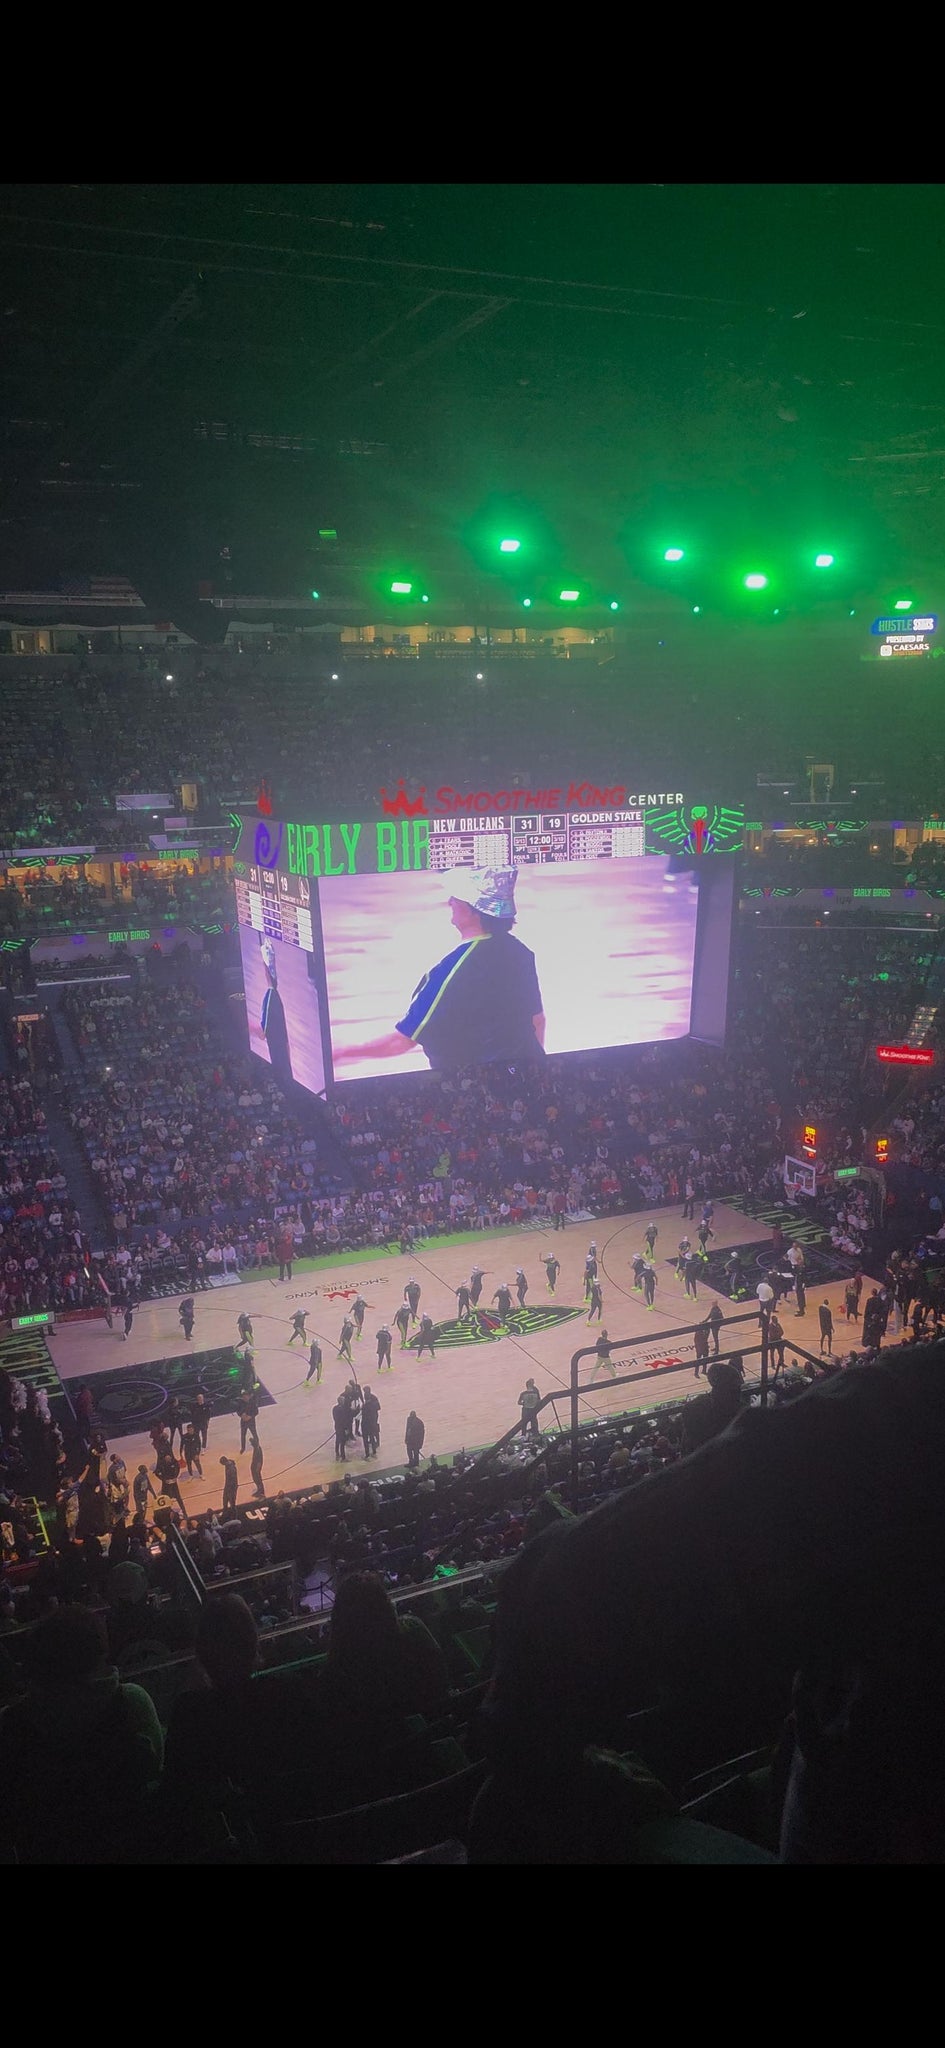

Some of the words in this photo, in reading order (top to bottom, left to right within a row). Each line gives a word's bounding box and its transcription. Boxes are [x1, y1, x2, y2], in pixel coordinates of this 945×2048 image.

[879, 620, 913, 632] HUSTLE
[433, 785, 561, 814] SMOOTHIE
[628, 792, 684, 806] CENTER
[549, 818, 561, 828] 19
[571, 813, 612, 823] GOLDEN
[614, 811, 642, 821] STATE
[433, 819, 456, 832] NEW
[460, 816, 505, 830] ORLEANS
[521, 819, 532, 829] 31
[529, 836, 551, 845] 12:00
[159, 850, 178, 859] EARLY
[287, 823, 361, 877] EARLY
[281, 876, 288, 891] 19
[853, 888, 872, 897] EARLY
[108, 931, 128, 942] EARLY
[130, 930, 150, 940] BIRDS
[323, 1277, 390, 1292] SMOOTHIE
[642, 1345, 696, 1361] MOOTHIE
